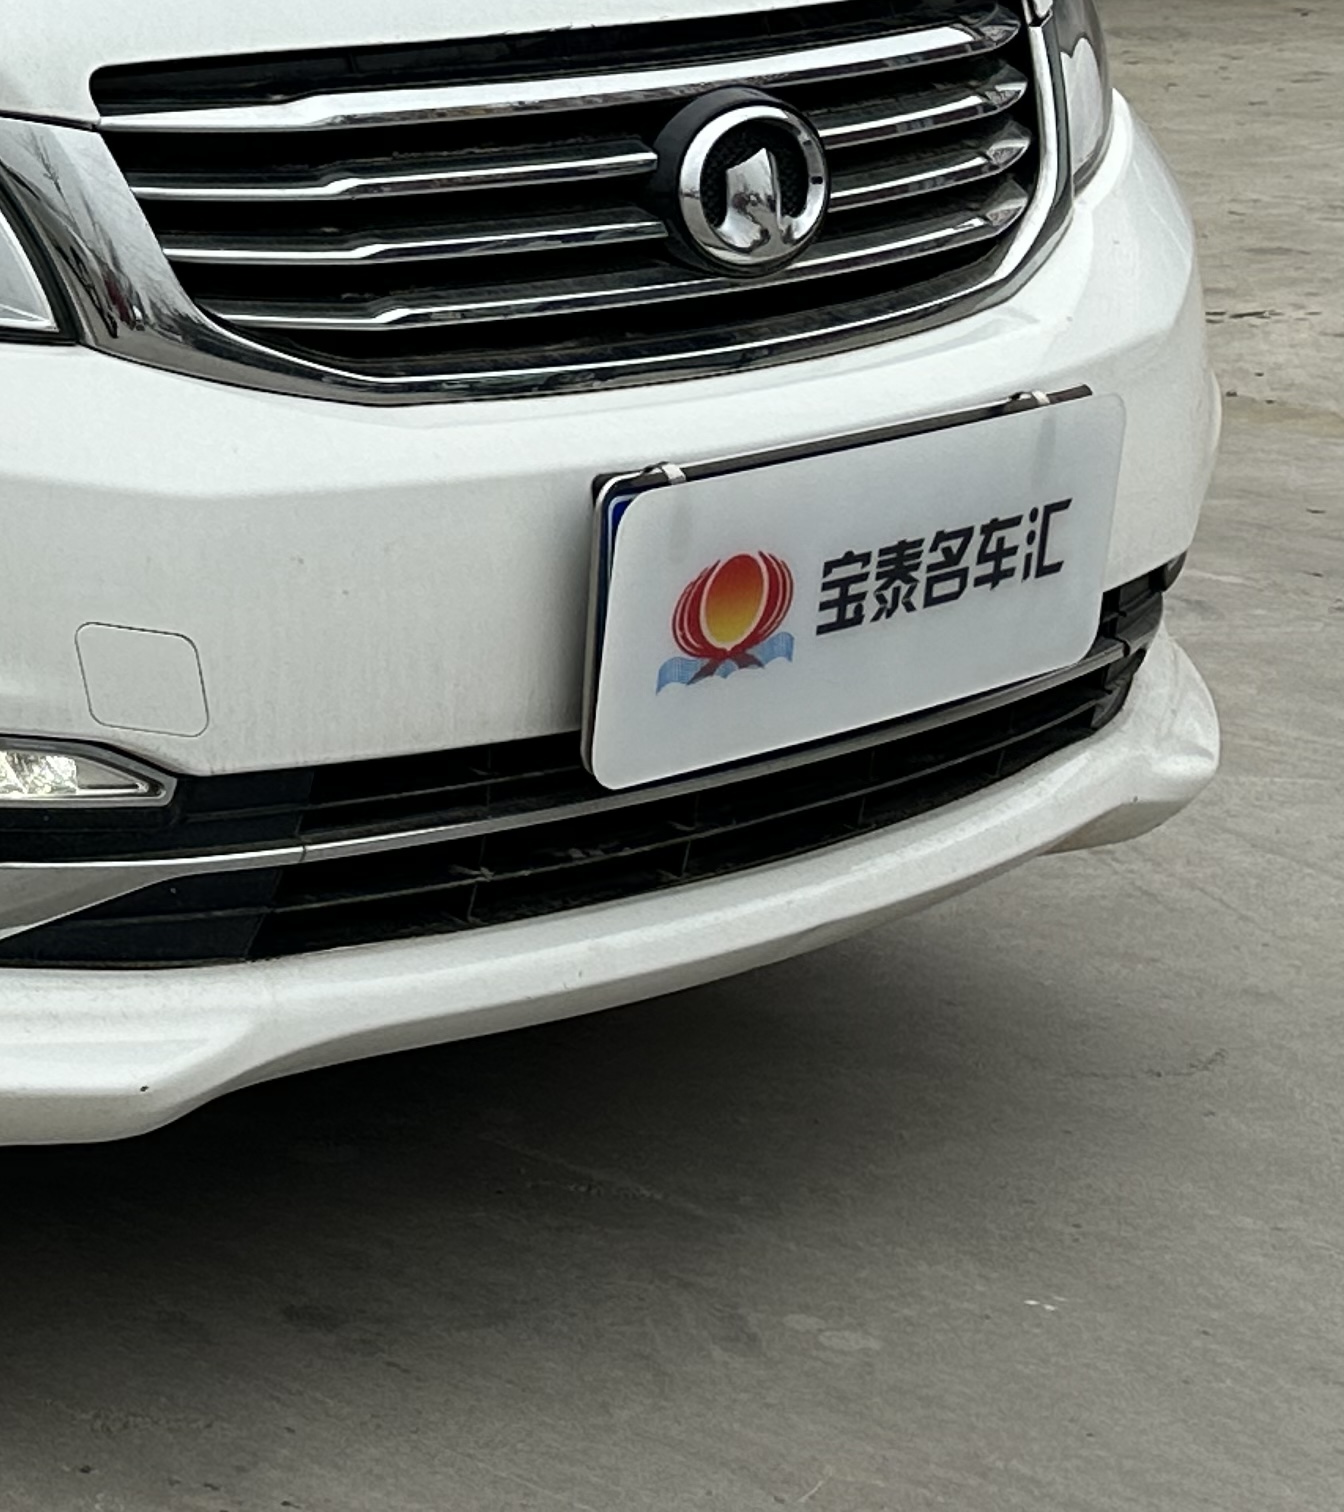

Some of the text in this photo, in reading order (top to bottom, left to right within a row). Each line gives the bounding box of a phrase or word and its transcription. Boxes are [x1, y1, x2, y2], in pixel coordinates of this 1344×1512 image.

[815, 497, 1073, 636] 宝泰名车汇
